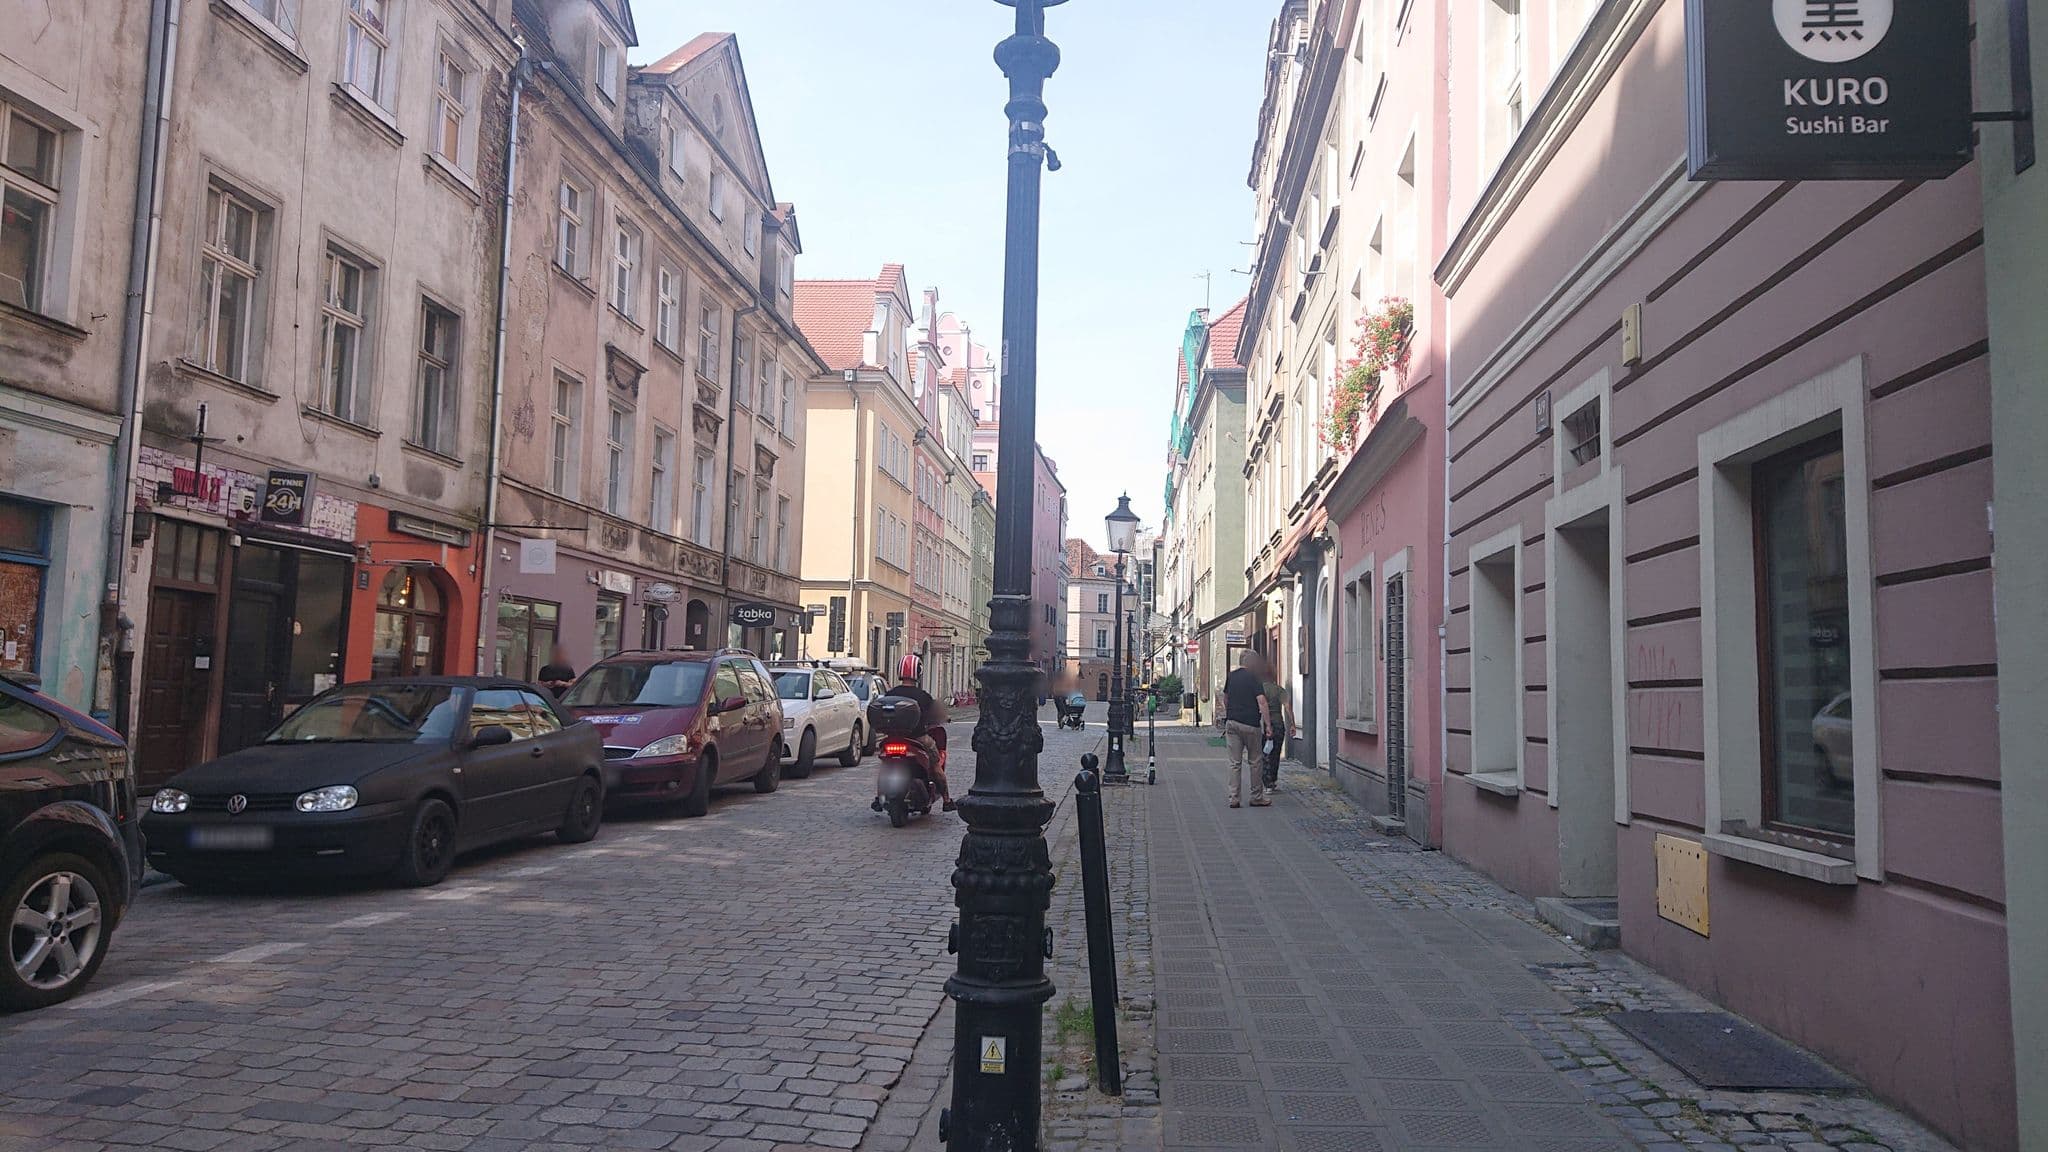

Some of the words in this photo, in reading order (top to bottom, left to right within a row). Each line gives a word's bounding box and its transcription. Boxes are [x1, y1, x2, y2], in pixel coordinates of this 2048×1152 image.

[1784, 77, 1888, 105] KURO
[1786, 116, 1844, 134] Sushi
[1851, 116, 1889, 134] Bar
[270, 477, 305, 488] CZYNNE
[266, 494, 302, 510] 24H
[738, 608, 772, 619] żabka
